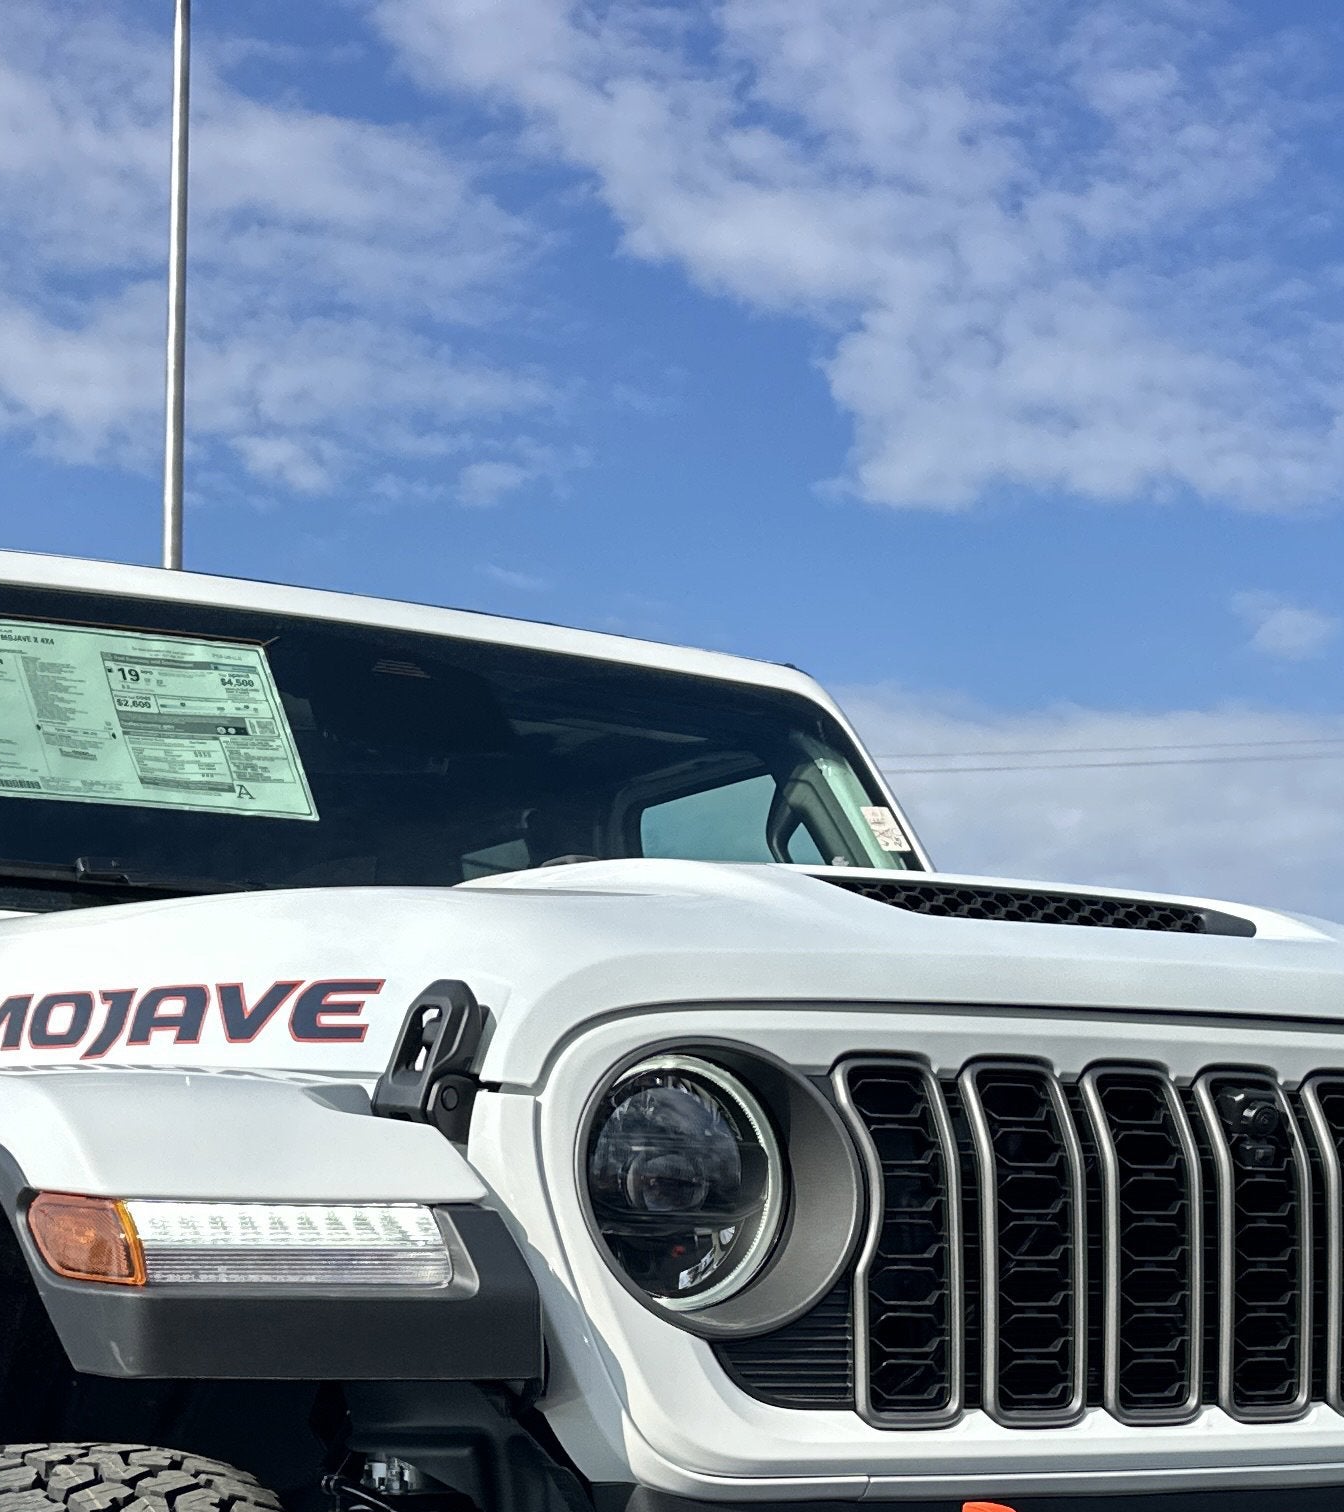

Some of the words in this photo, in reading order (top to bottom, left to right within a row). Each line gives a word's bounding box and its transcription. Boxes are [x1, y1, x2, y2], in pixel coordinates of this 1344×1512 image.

[117, 667, 140, 682] 19
[220, 678, 255, 688] $4,500
[236, 784, 257, 800] A
